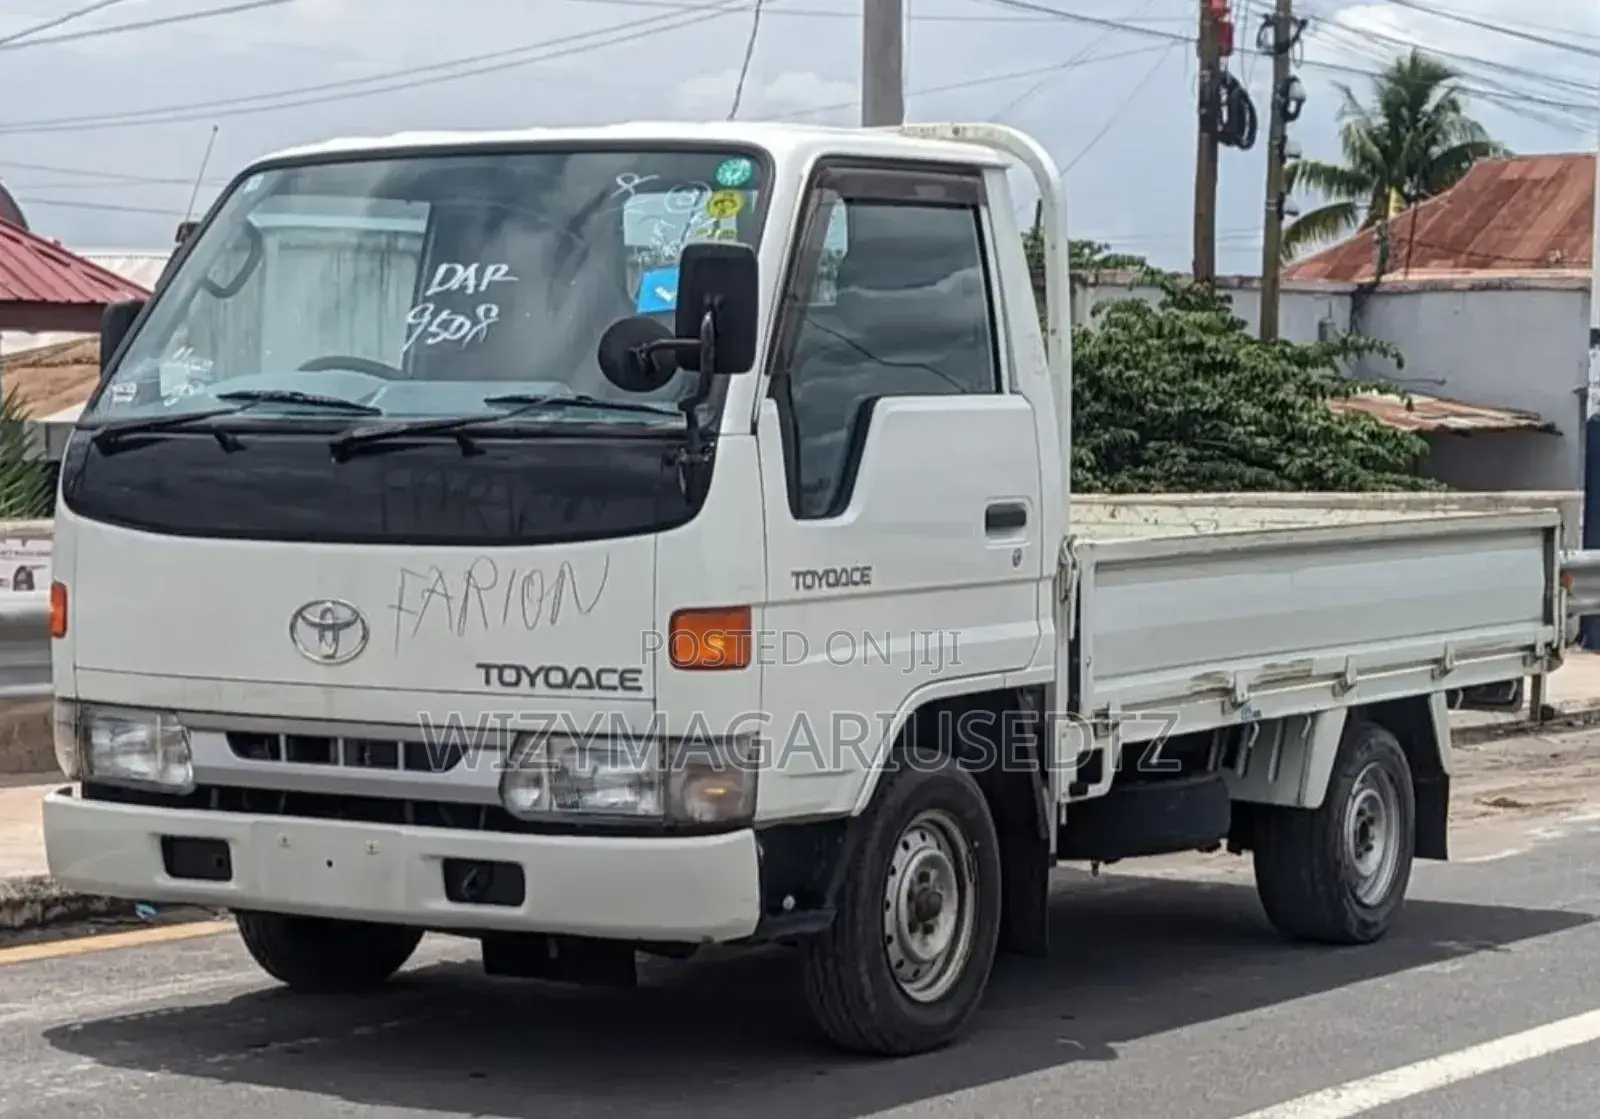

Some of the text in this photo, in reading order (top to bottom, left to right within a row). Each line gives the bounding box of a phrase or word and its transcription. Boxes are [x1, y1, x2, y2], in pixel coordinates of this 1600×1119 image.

[791, 565, 873, 591] TOYOACE
[387, 552, 610, 659] FARION
[475, 662, 644, 692] TOYOACE
